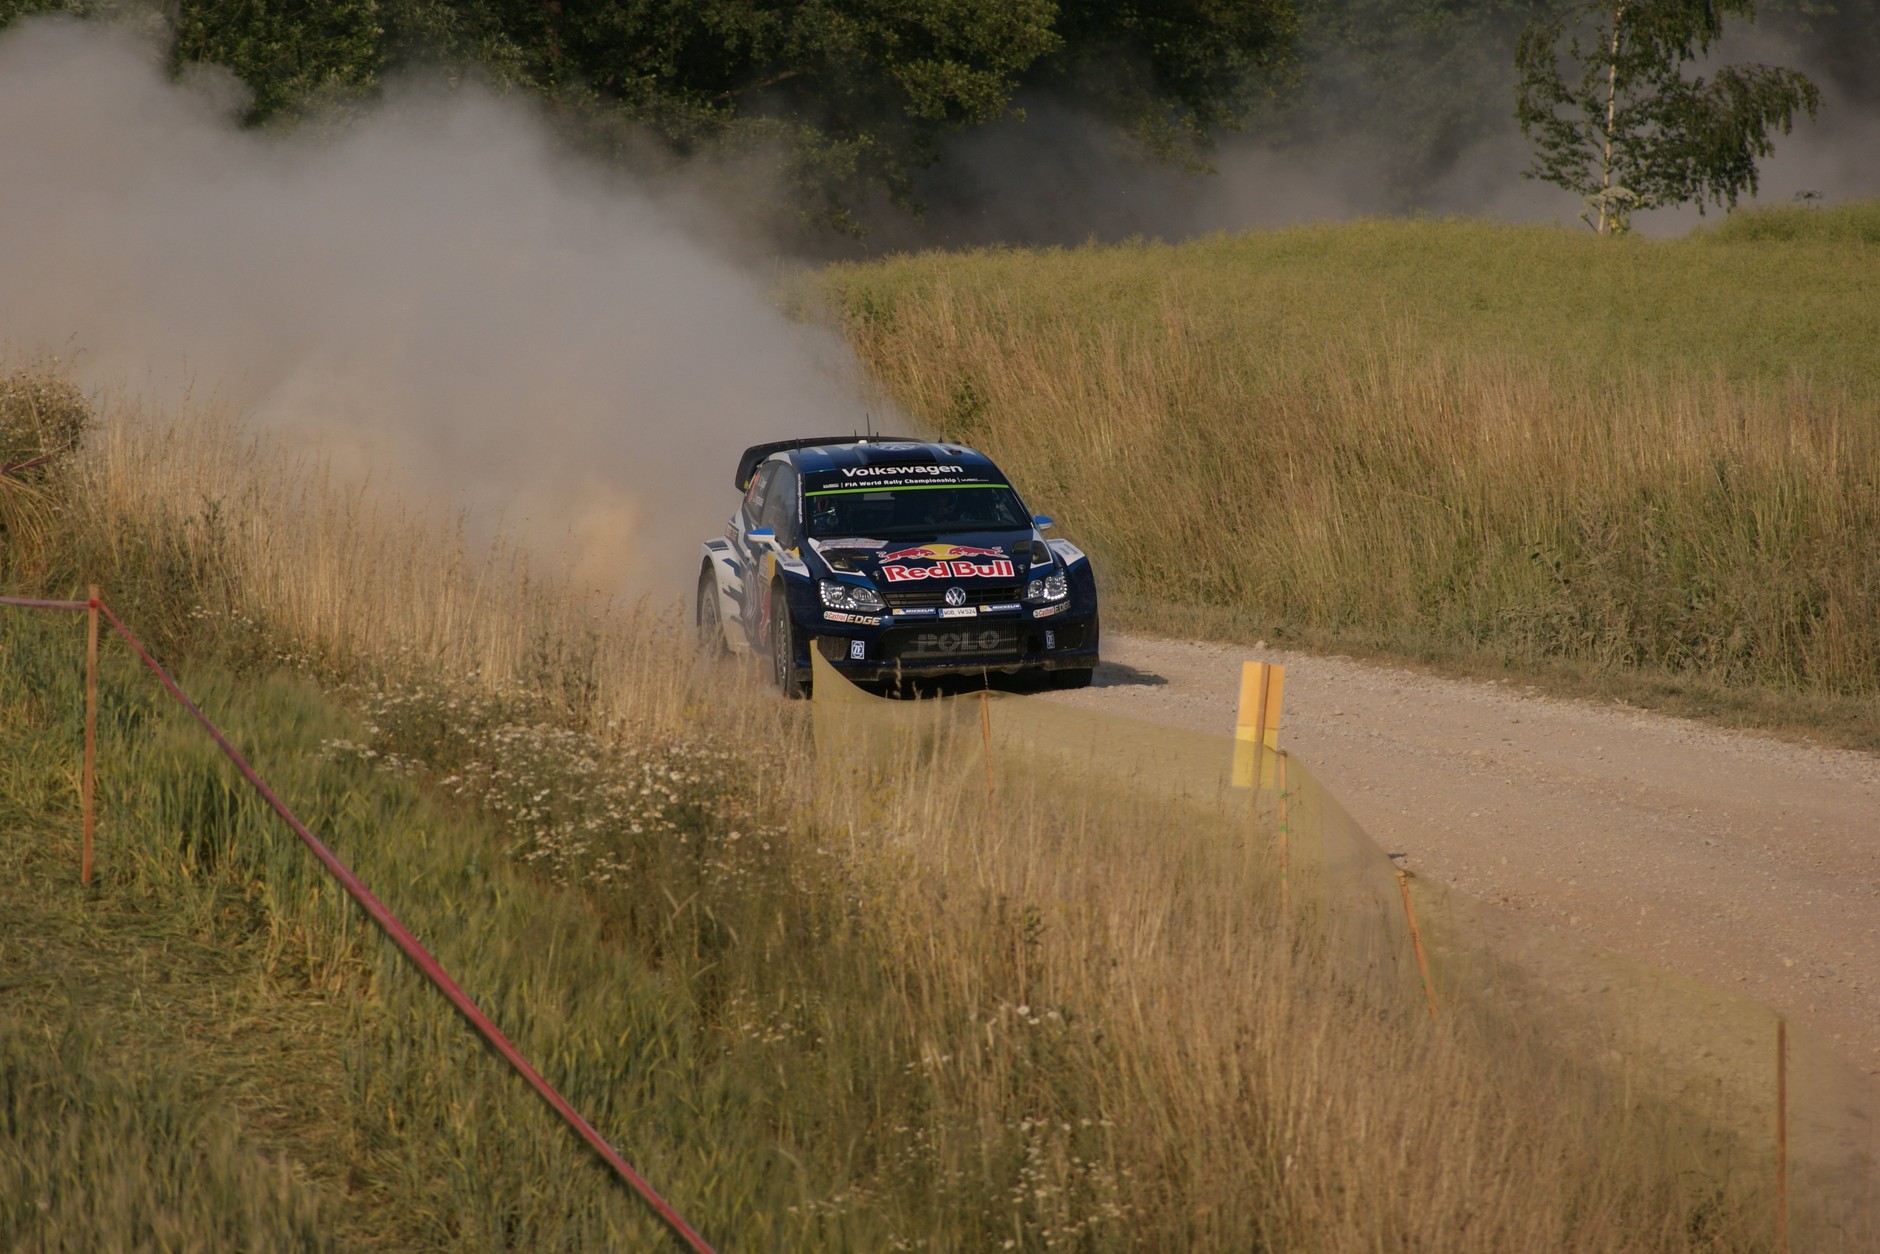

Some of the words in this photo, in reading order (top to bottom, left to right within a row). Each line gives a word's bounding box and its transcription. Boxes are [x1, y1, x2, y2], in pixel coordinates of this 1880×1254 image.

[842, 465, 963, 477] Volkswagen
[904, 477, 957, 485] Championship
[882, 561, 951, 582] Red
[951, 560, 1015, 577] Bull
[1055, 600, 1071, 613] EDGE
[828, 612, 846, 621] Castrol
[847, 614, 882, 626] EDGE
[918, 631, 999, 652] POLO
